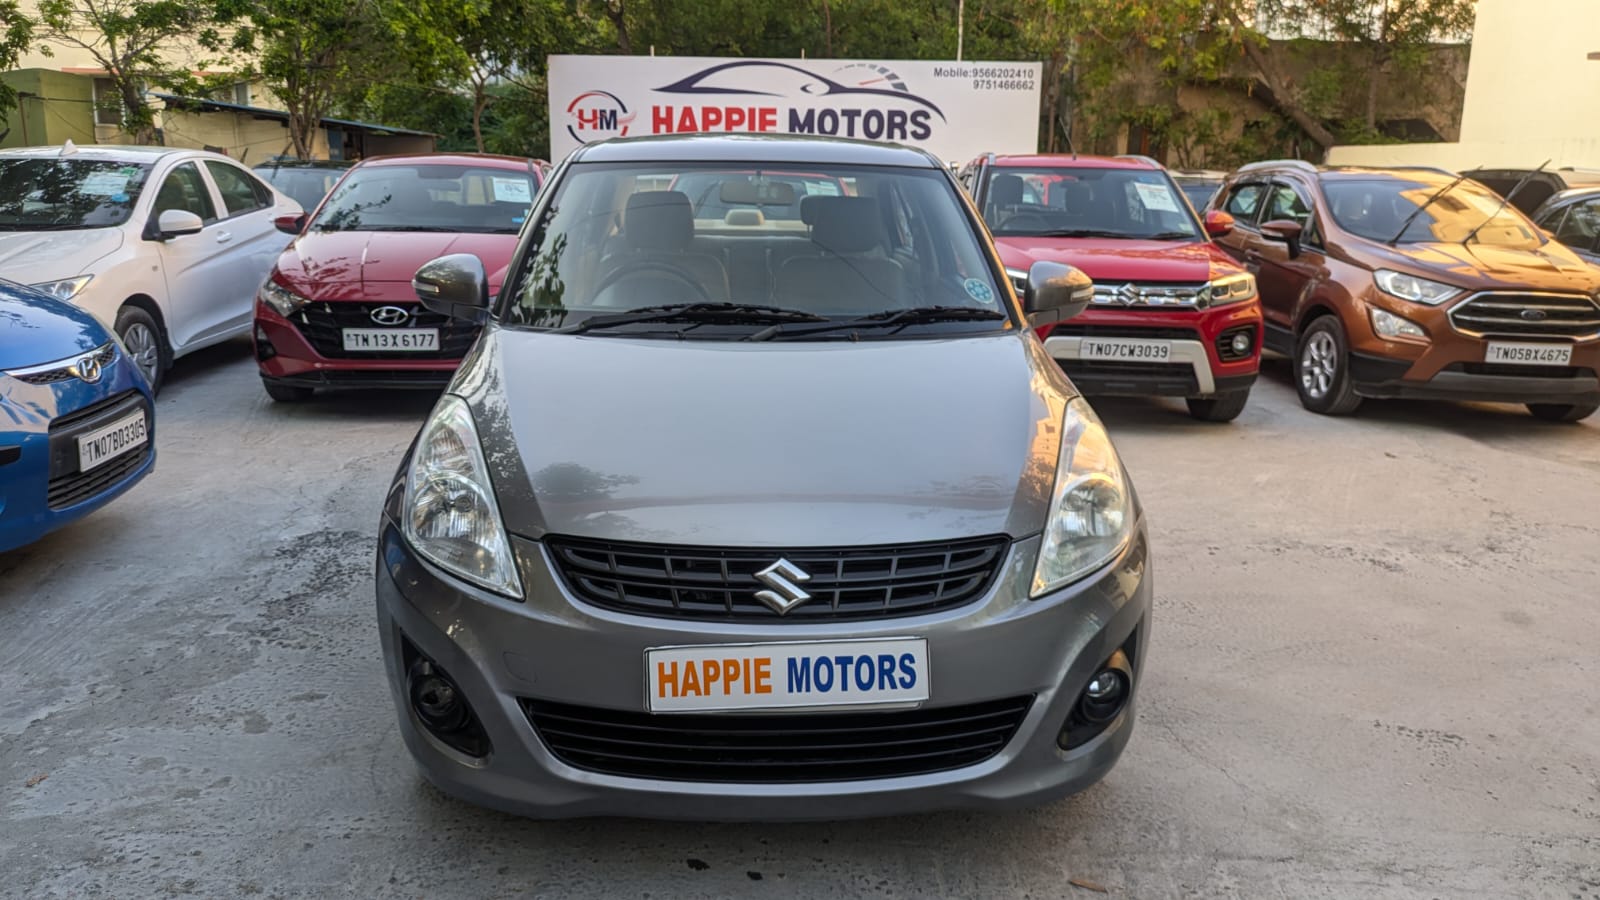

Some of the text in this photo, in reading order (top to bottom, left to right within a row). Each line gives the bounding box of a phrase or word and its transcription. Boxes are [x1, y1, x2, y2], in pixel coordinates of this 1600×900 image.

[973, 79, 1034, 90] 9751466662
[578, 108, 617, 130] HM
[652, 105, 932, 141] HAPPIE MOTORS
[353, 333, 434, 347] TN 13 X 6177
[1088, 343, 1168, 359] TN07CW3039
[1495, 347, 1569, 362] TN05BX4675
[87, 418, 145, 462] TN07BD3305
[658, 653, 917, 698] HAPPIE MOTORS
